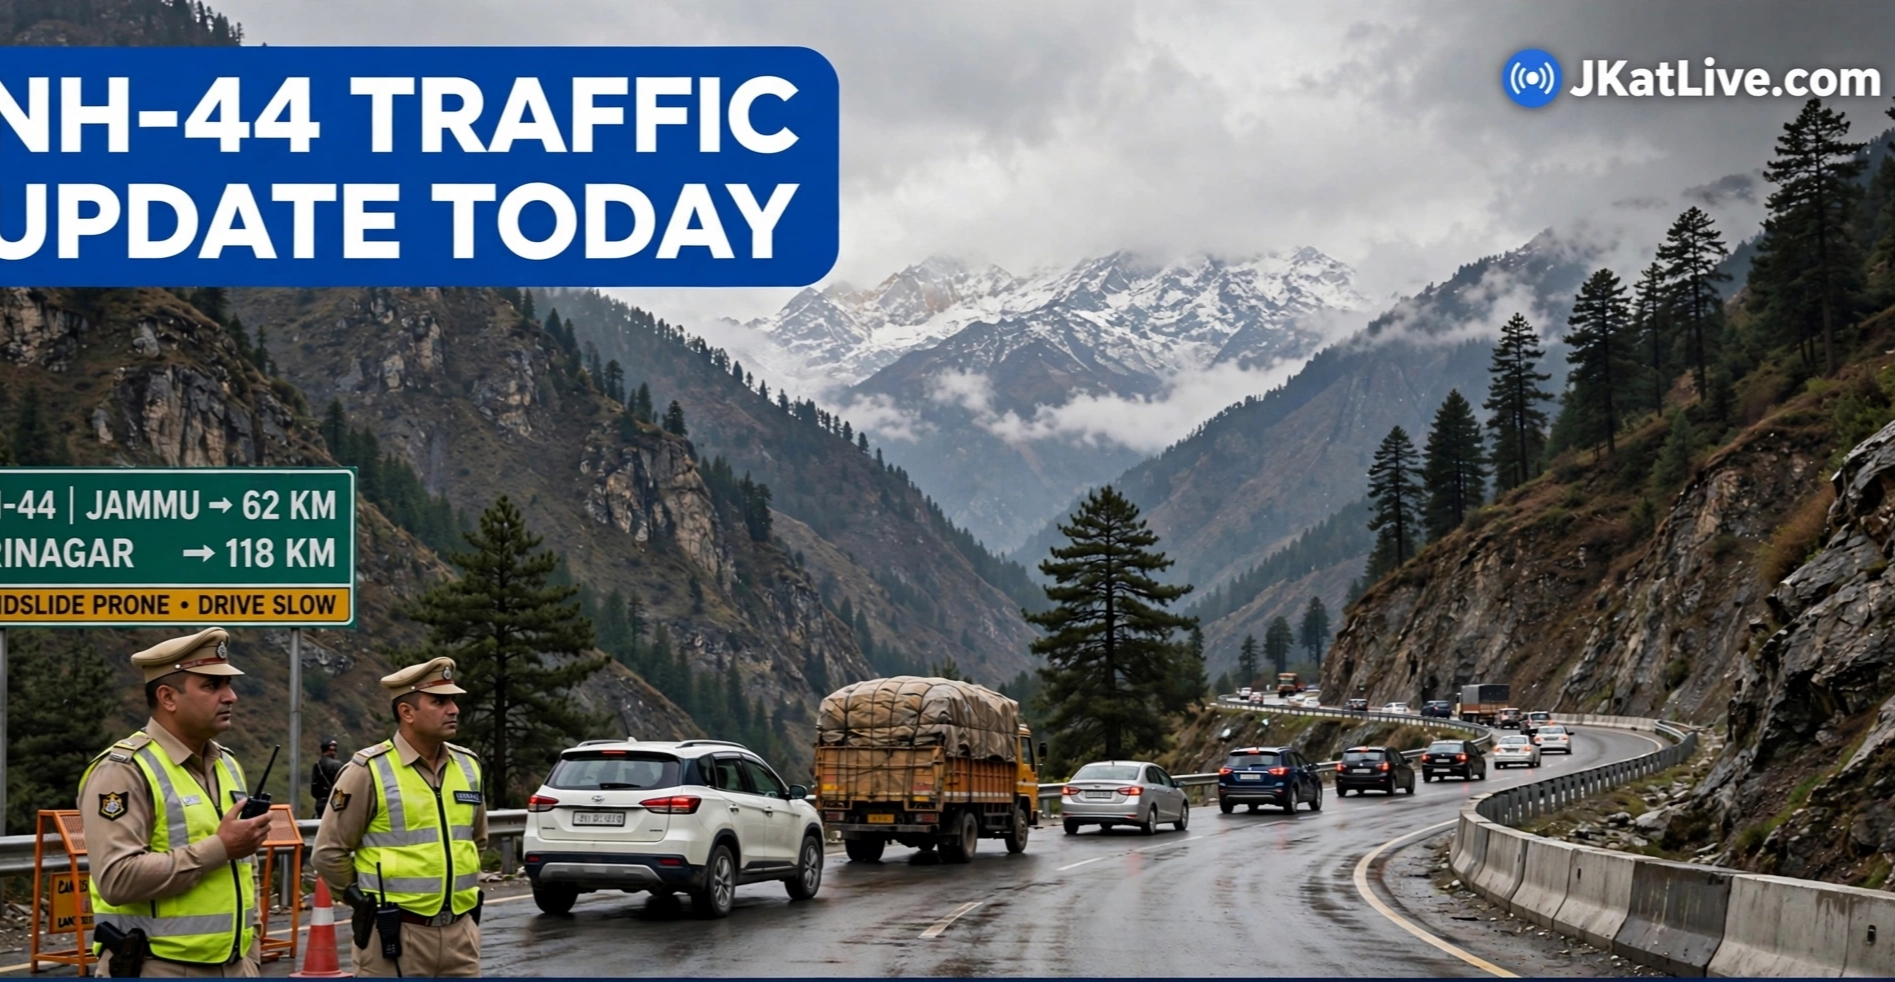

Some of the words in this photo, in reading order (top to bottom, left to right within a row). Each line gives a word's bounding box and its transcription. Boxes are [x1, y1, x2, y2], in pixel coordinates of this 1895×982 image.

[0, 490, 56, 519] -44
[86, 490, 200, 520] JAMMU
[242, 490, 280, 520] 62
[290, 490, 336, 520] KM
[0, 537, 134, 568] INAGAR
[226, 537, 274, 568] 118
[286, 537, 335, 568] KM
[0, 594, 85, 615] DSLIDE
[93, 594, 170, 615] PRONE
[198, 594, 265, 615] DRIVE
[273, 594, 337, 615] SLOW
